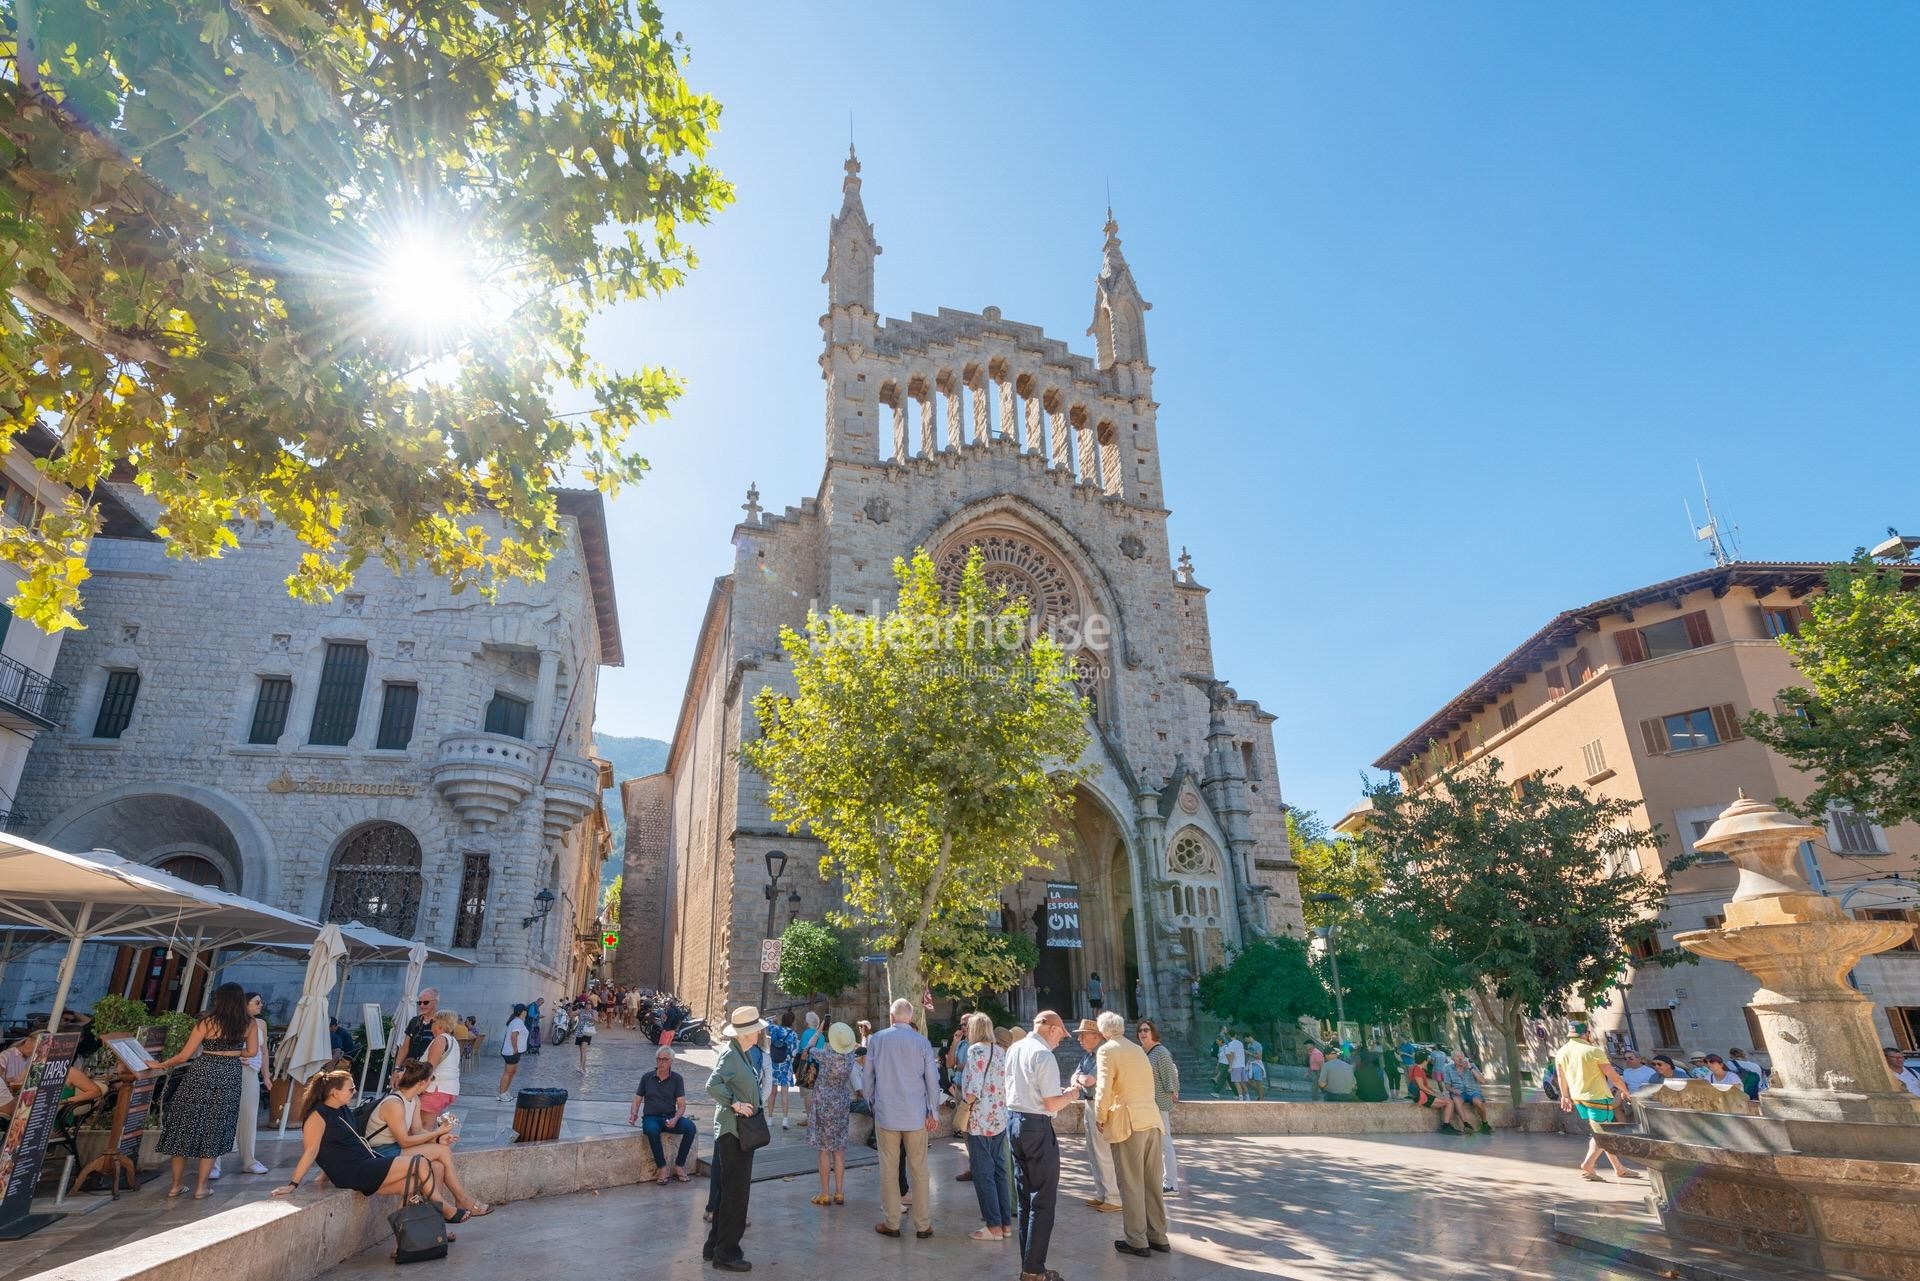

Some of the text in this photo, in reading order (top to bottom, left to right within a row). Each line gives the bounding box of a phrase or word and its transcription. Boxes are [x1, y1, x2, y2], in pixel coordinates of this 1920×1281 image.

[302, 776, 417, 796] Santander
[1048, 913, 1078, 930] ON
[43, 1060, 69, 1080] TAPAS
